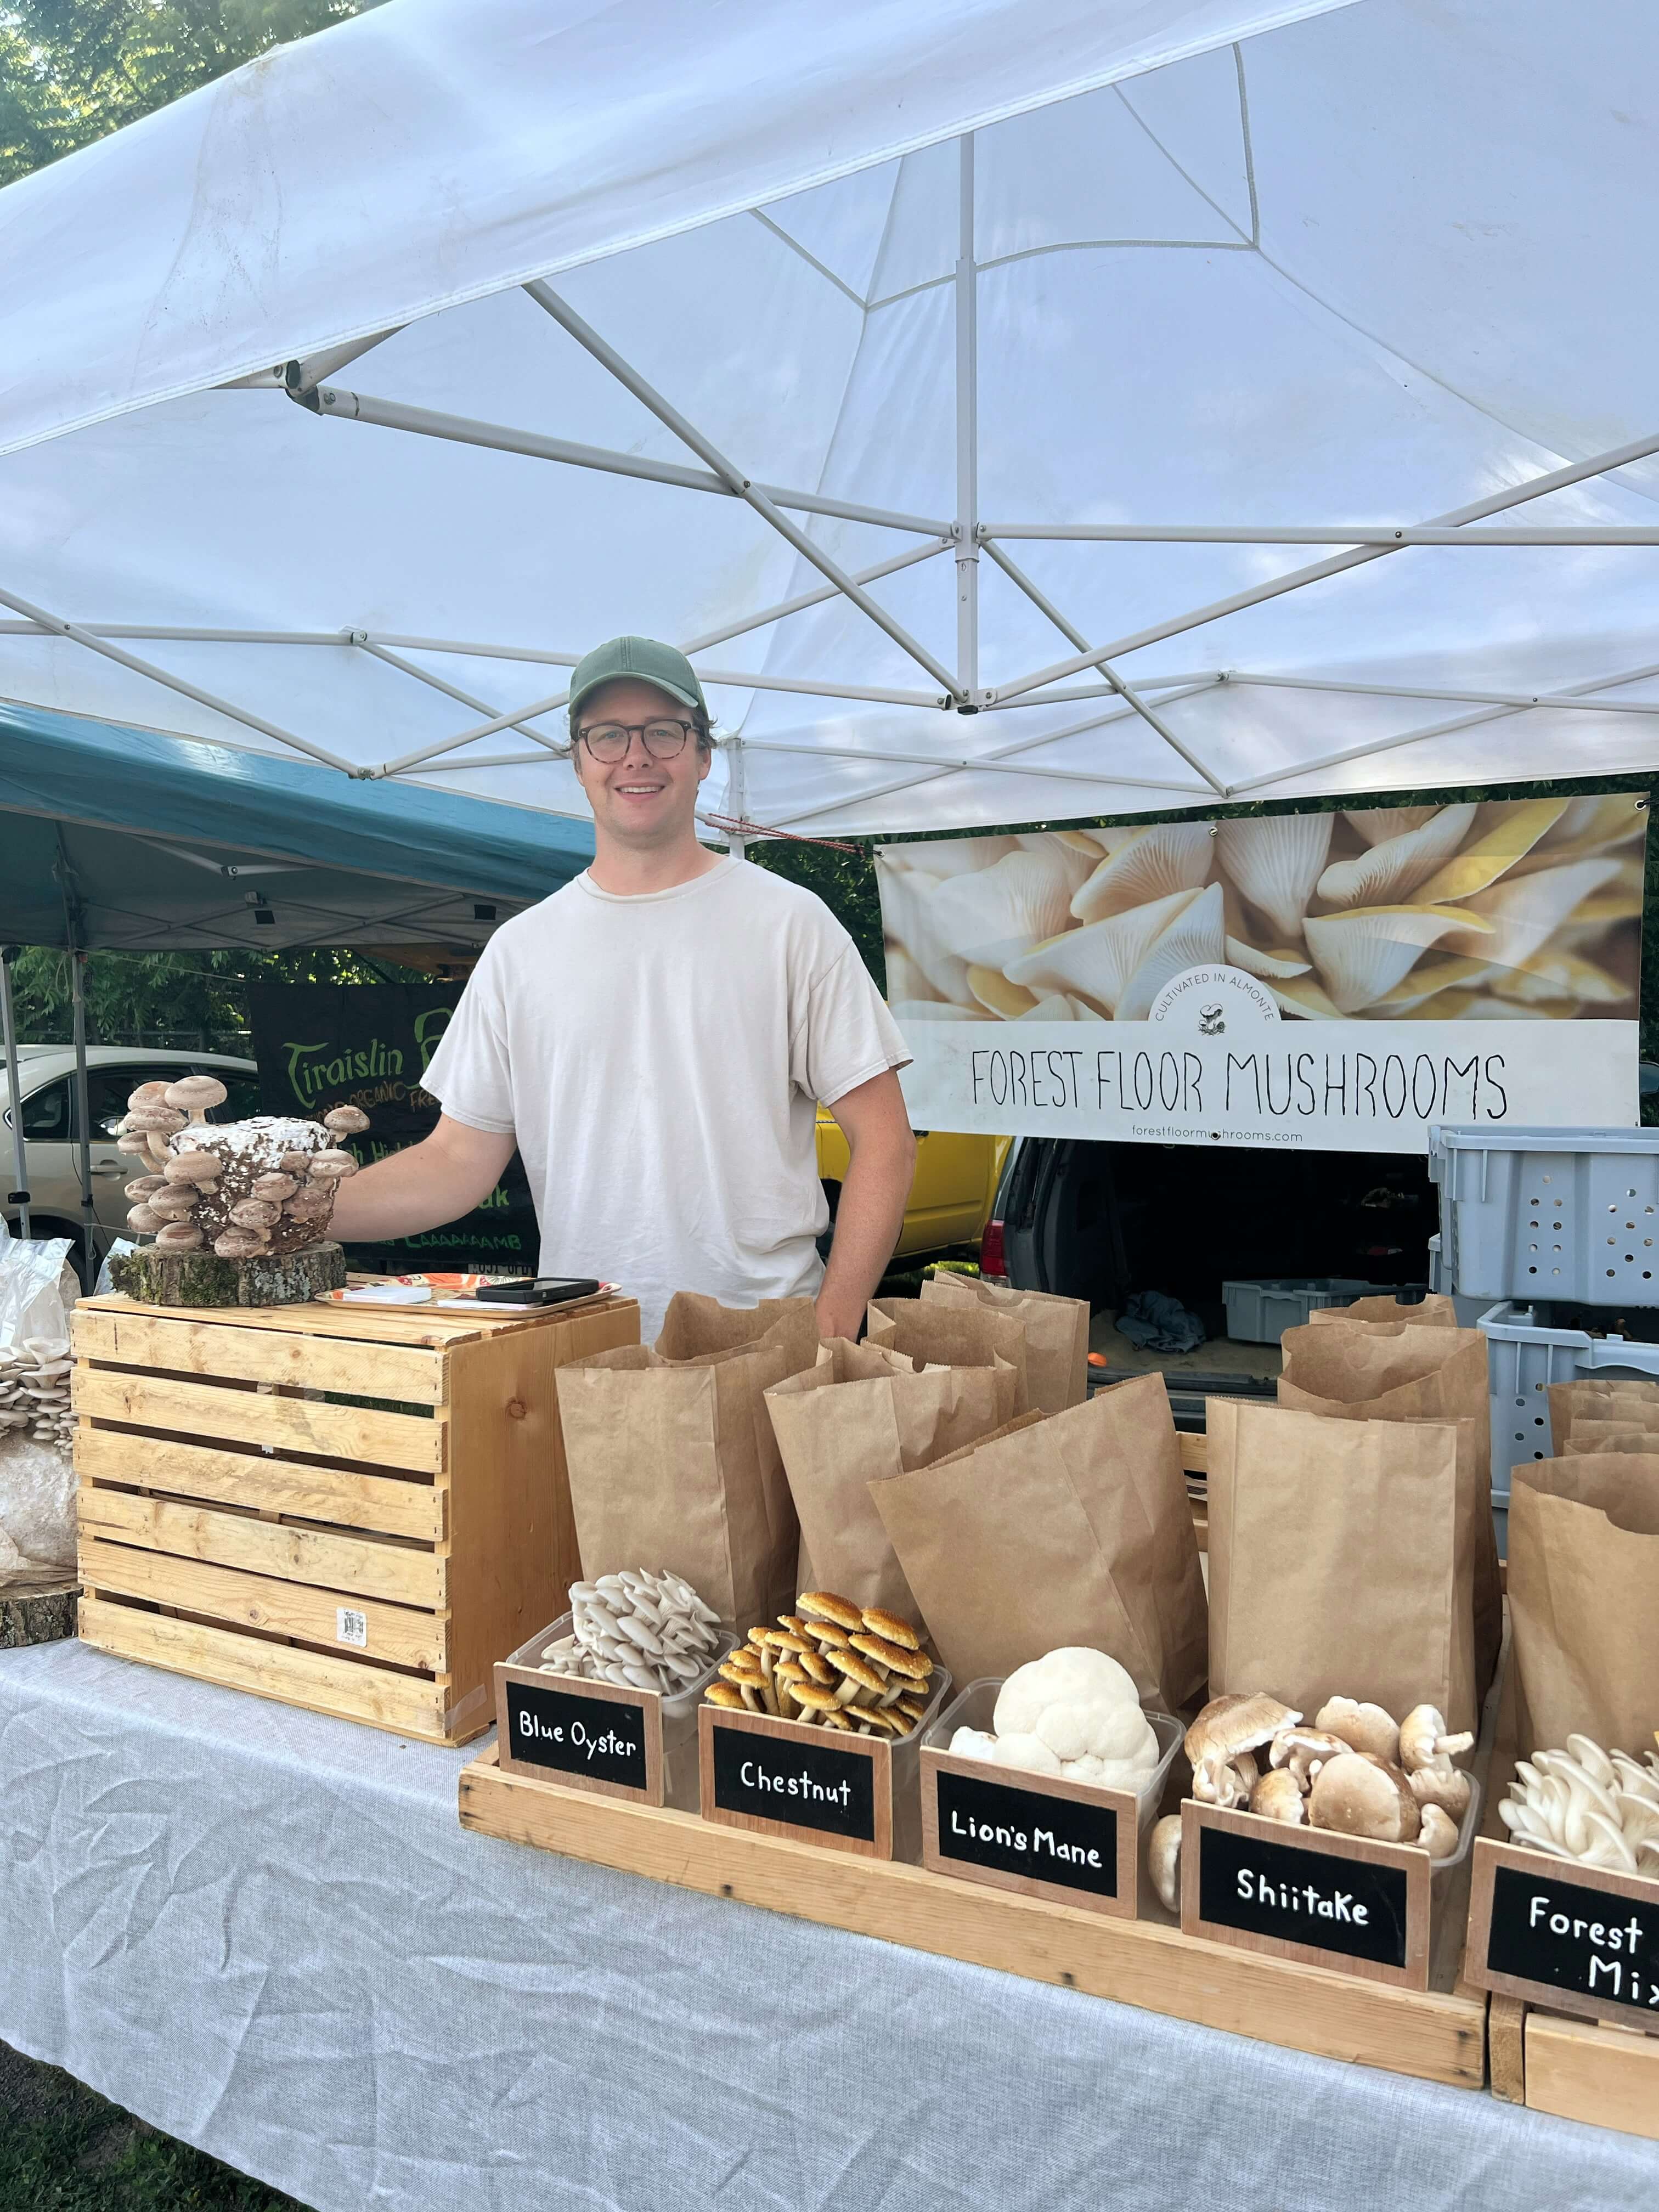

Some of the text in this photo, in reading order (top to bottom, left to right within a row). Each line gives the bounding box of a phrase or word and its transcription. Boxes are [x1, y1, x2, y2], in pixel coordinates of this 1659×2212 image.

[1155, 973, 1274, 1021] CULTIVATED IN ALMONTE
[281, 1038, 404, 1109] Tiraislin
[349, 1080, 405, 1108] ORGANIC
[972, 1050, 1508, 1120] FOREST FLOOR MUSHROOMS
[519, 1711, 636, 1760] Blue Oyster
[740, 1761, 851, 1807] Chestnut
[951, 1810, 1103, 1869] Lion's Mane
[1529, 1896, 1644, 1954] Forest
